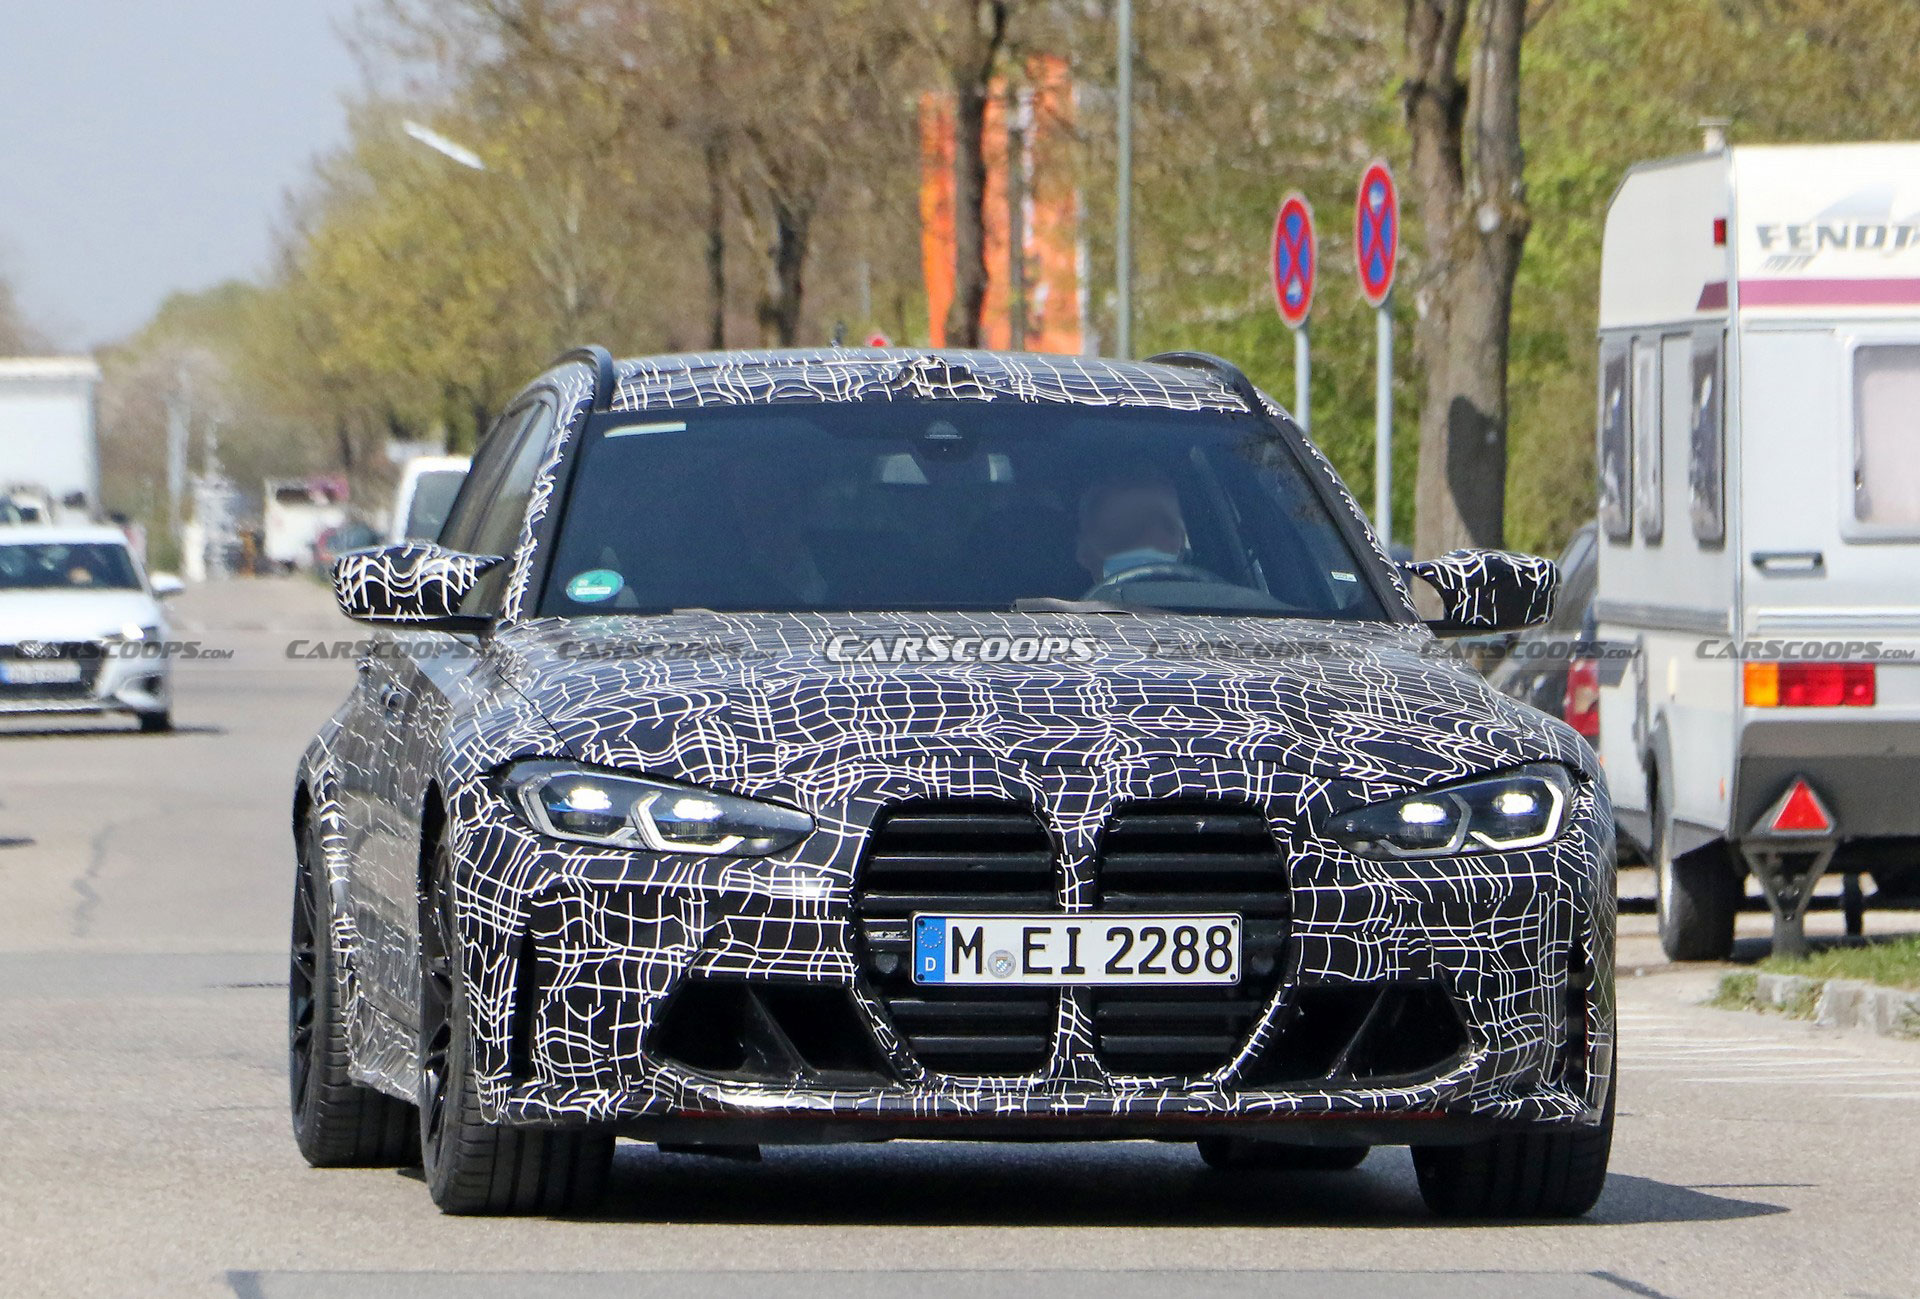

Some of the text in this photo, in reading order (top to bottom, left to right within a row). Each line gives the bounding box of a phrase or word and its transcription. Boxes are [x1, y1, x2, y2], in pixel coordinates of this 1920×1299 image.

[925, 957, 937, 971] D
[951, 925, 1234, 975] M EI 2288
